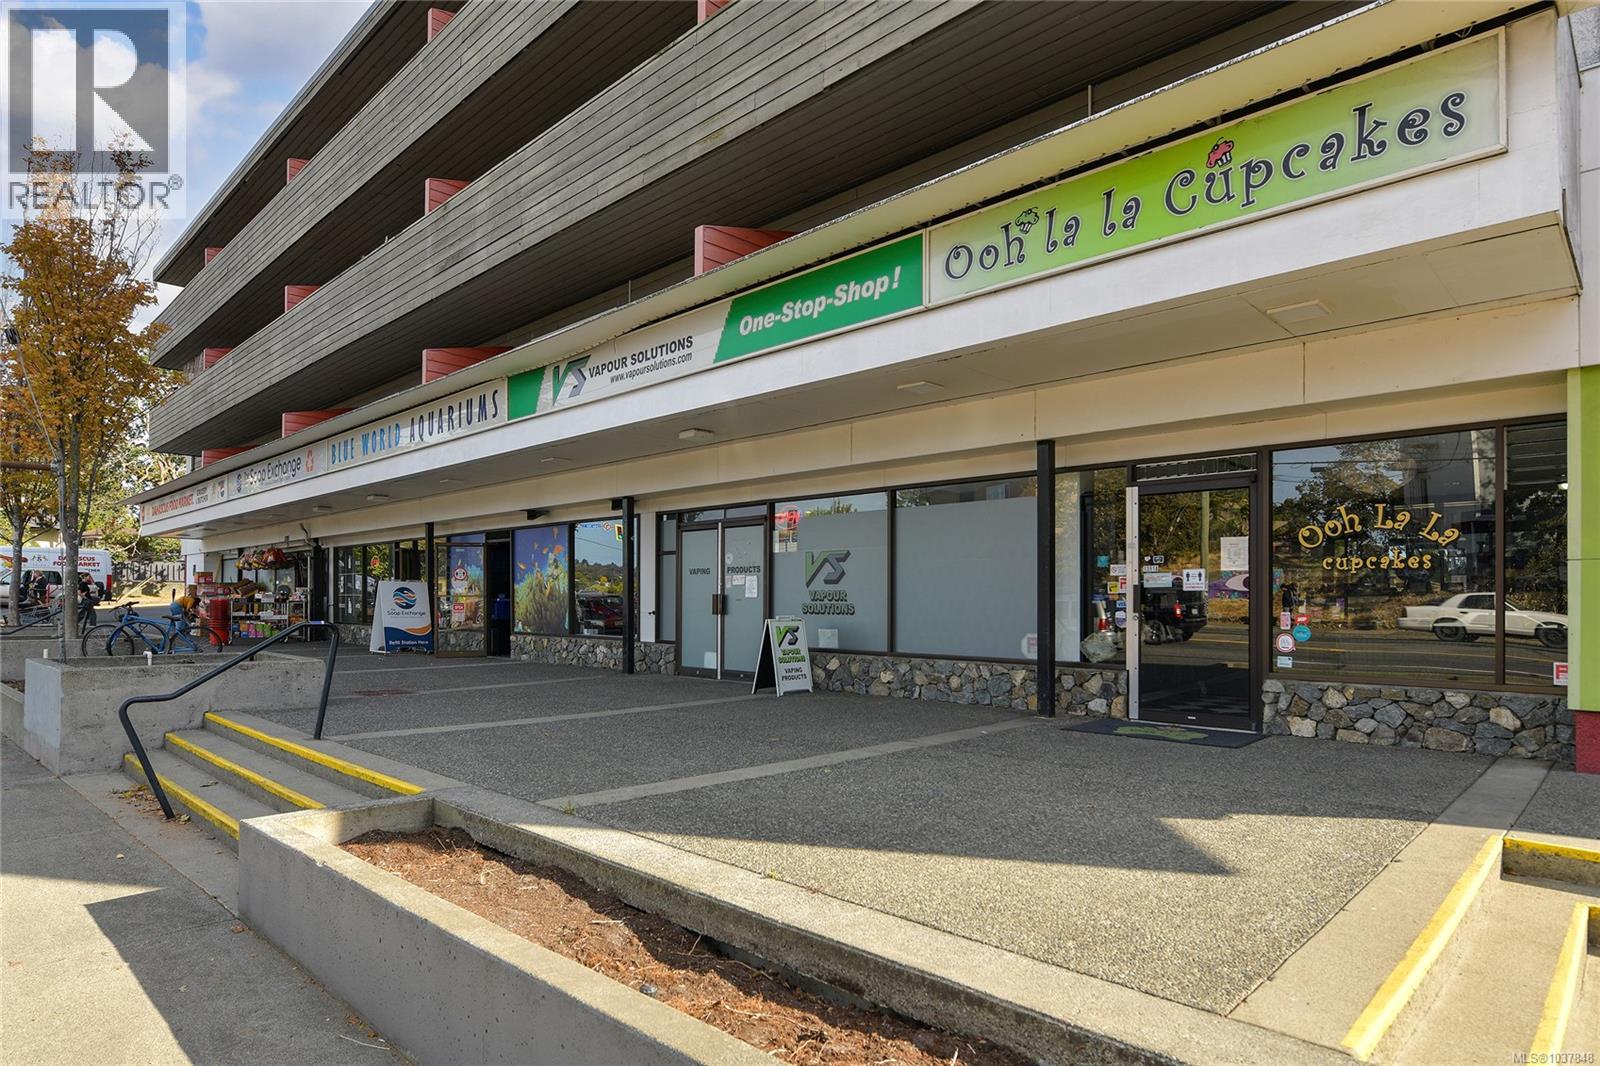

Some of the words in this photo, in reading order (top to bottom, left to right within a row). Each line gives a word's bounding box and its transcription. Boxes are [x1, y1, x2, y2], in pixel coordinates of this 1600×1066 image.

[945, 221, 1025, 279] Ooh
[1045, 207, 1081, 253] la
[1103, 187, 1141, 236] la
[1164, 91, 1467, 215] Cupcakes
[739, 265, 902, 336] One-Stop-Shop!
[588, 355, 628, 378] VAPOUR
[630, 335, 694, 366] SOLUTIONS
[610, 351, 693, 384] www.vapoursolutions.com
[331, 437, 355, 465] BLUE
[361, 422, 401, 457] WORLD
[409, 389, 499, 443] AQUARIUMS
[267, 456, 302, 480] Exchange
[1298, 504, 1362, 549] Ooh
[1374, 503, 1412, 530] La
[1419, 511, 1461, 546] La
[689, 567, 711, 575] VAPING
[727, 565, 761, 574] PRODUCTS
[1322, 549, 1433, 573] cupcakes
[808, 589, 848, 602] VAPOUR
[802, 602, 856, 616] SOLUTIONS
[781, 673, 807, 681] PRODUCTS
[784, 666, 803, 674] VAPING
